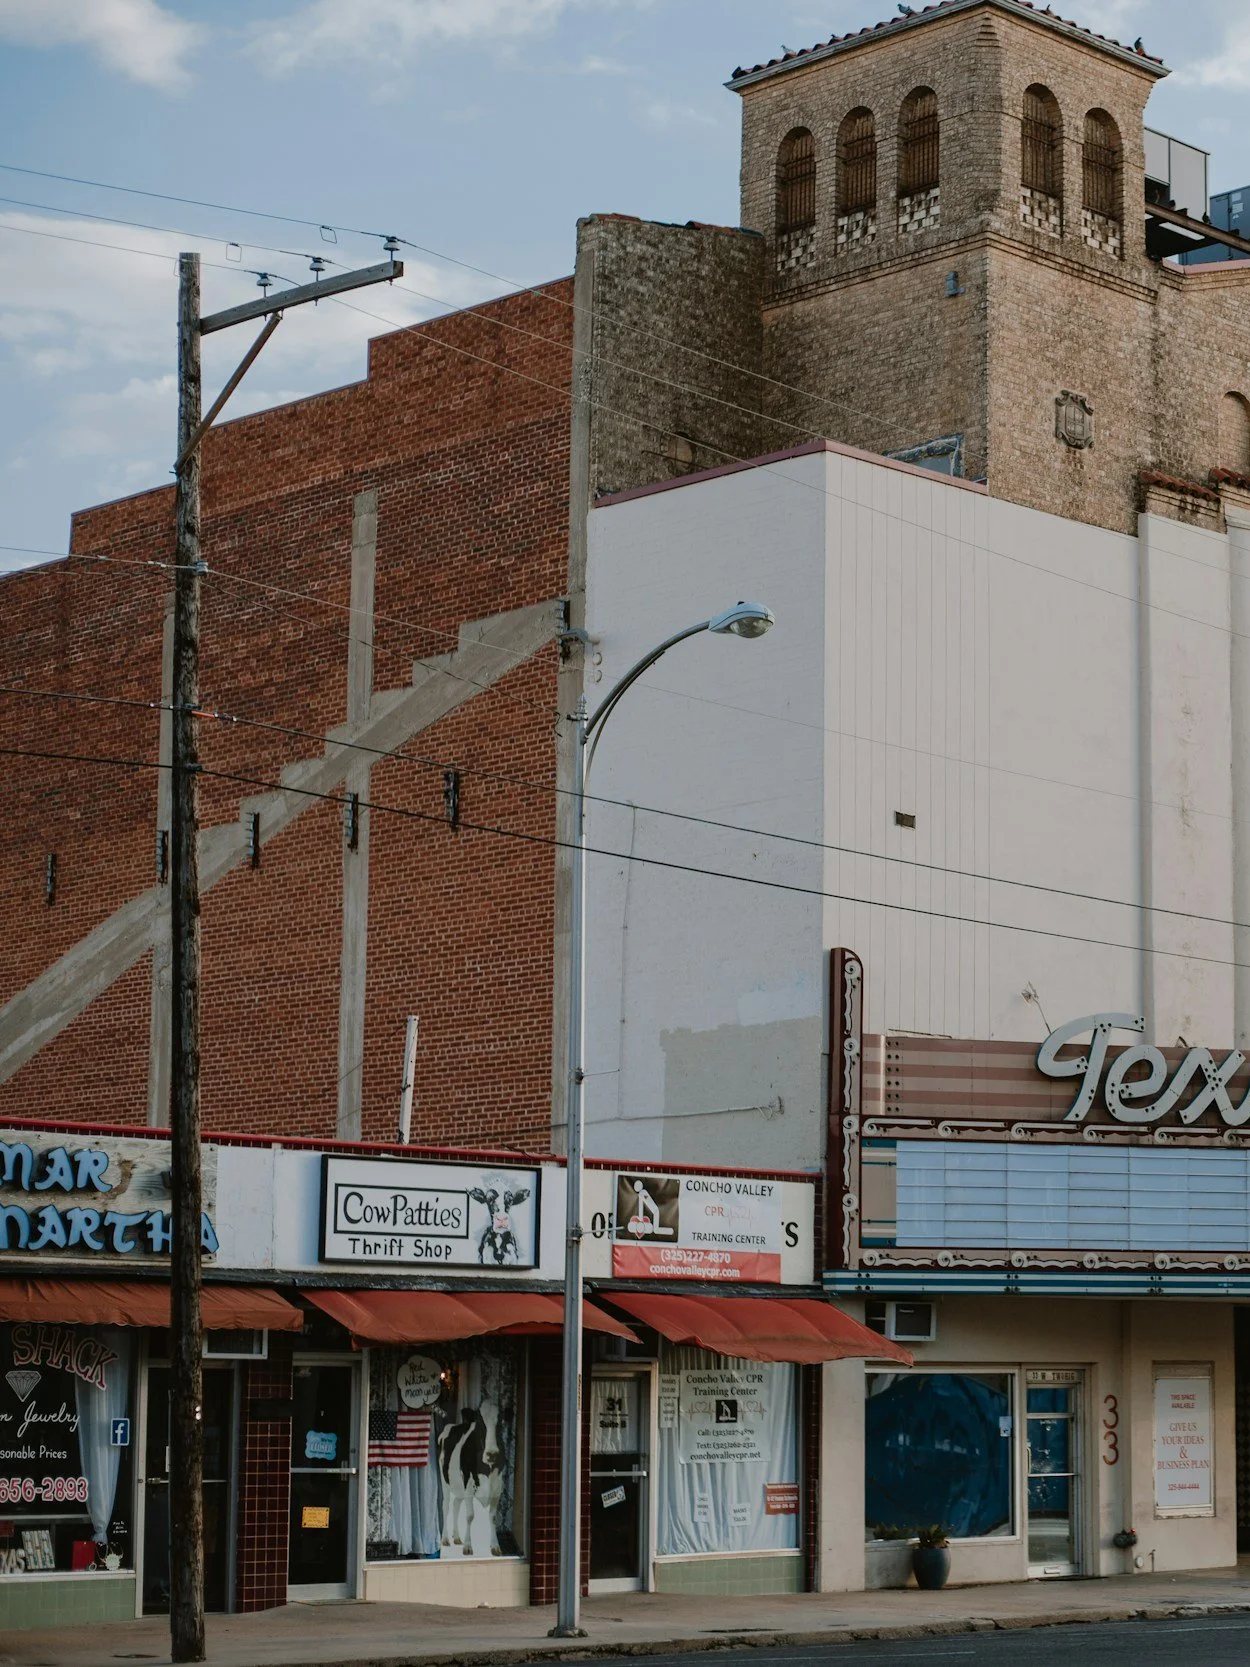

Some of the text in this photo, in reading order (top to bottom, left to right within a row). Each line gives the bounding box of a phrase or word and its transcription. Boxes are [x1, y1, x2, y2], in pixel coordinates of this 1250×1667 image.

[686, 1179, 774, 1198] CONCHO VALLEY
[343, 1191, 462, 1229] CowPatties
[704, 1204, 724, 1218] CPR
[692, 1232, 766, 1245] TRAINING CENTER
[348, 1238, 452, 1260] Thrift Shop
[649, 1264, 741, 1278] conchovalleycpr.com
[11, 1323, 119, 1391] SHACK
[686, 1374, 718, 1384] Concho
[745, 1374, 764, 1384] CPR
[693, 1387, 758, 1397] Training Center
[17, 1401, 80, 1438] Jewelry
[600, 1420, 619, 1428] Suite
[1169, 1422, 1186, 1431] GIVE
[1161, 1435, 1205, 1446] YOUR IDEAS
[0, 1445, 68, 1460] sonable Prices
[690, 1450, 761, 1461] conchovalleycpr.net
[1179, 1445, 1188, 1459] &
[1157, 1459, 1210, 1470] BUSINESS PLAN
